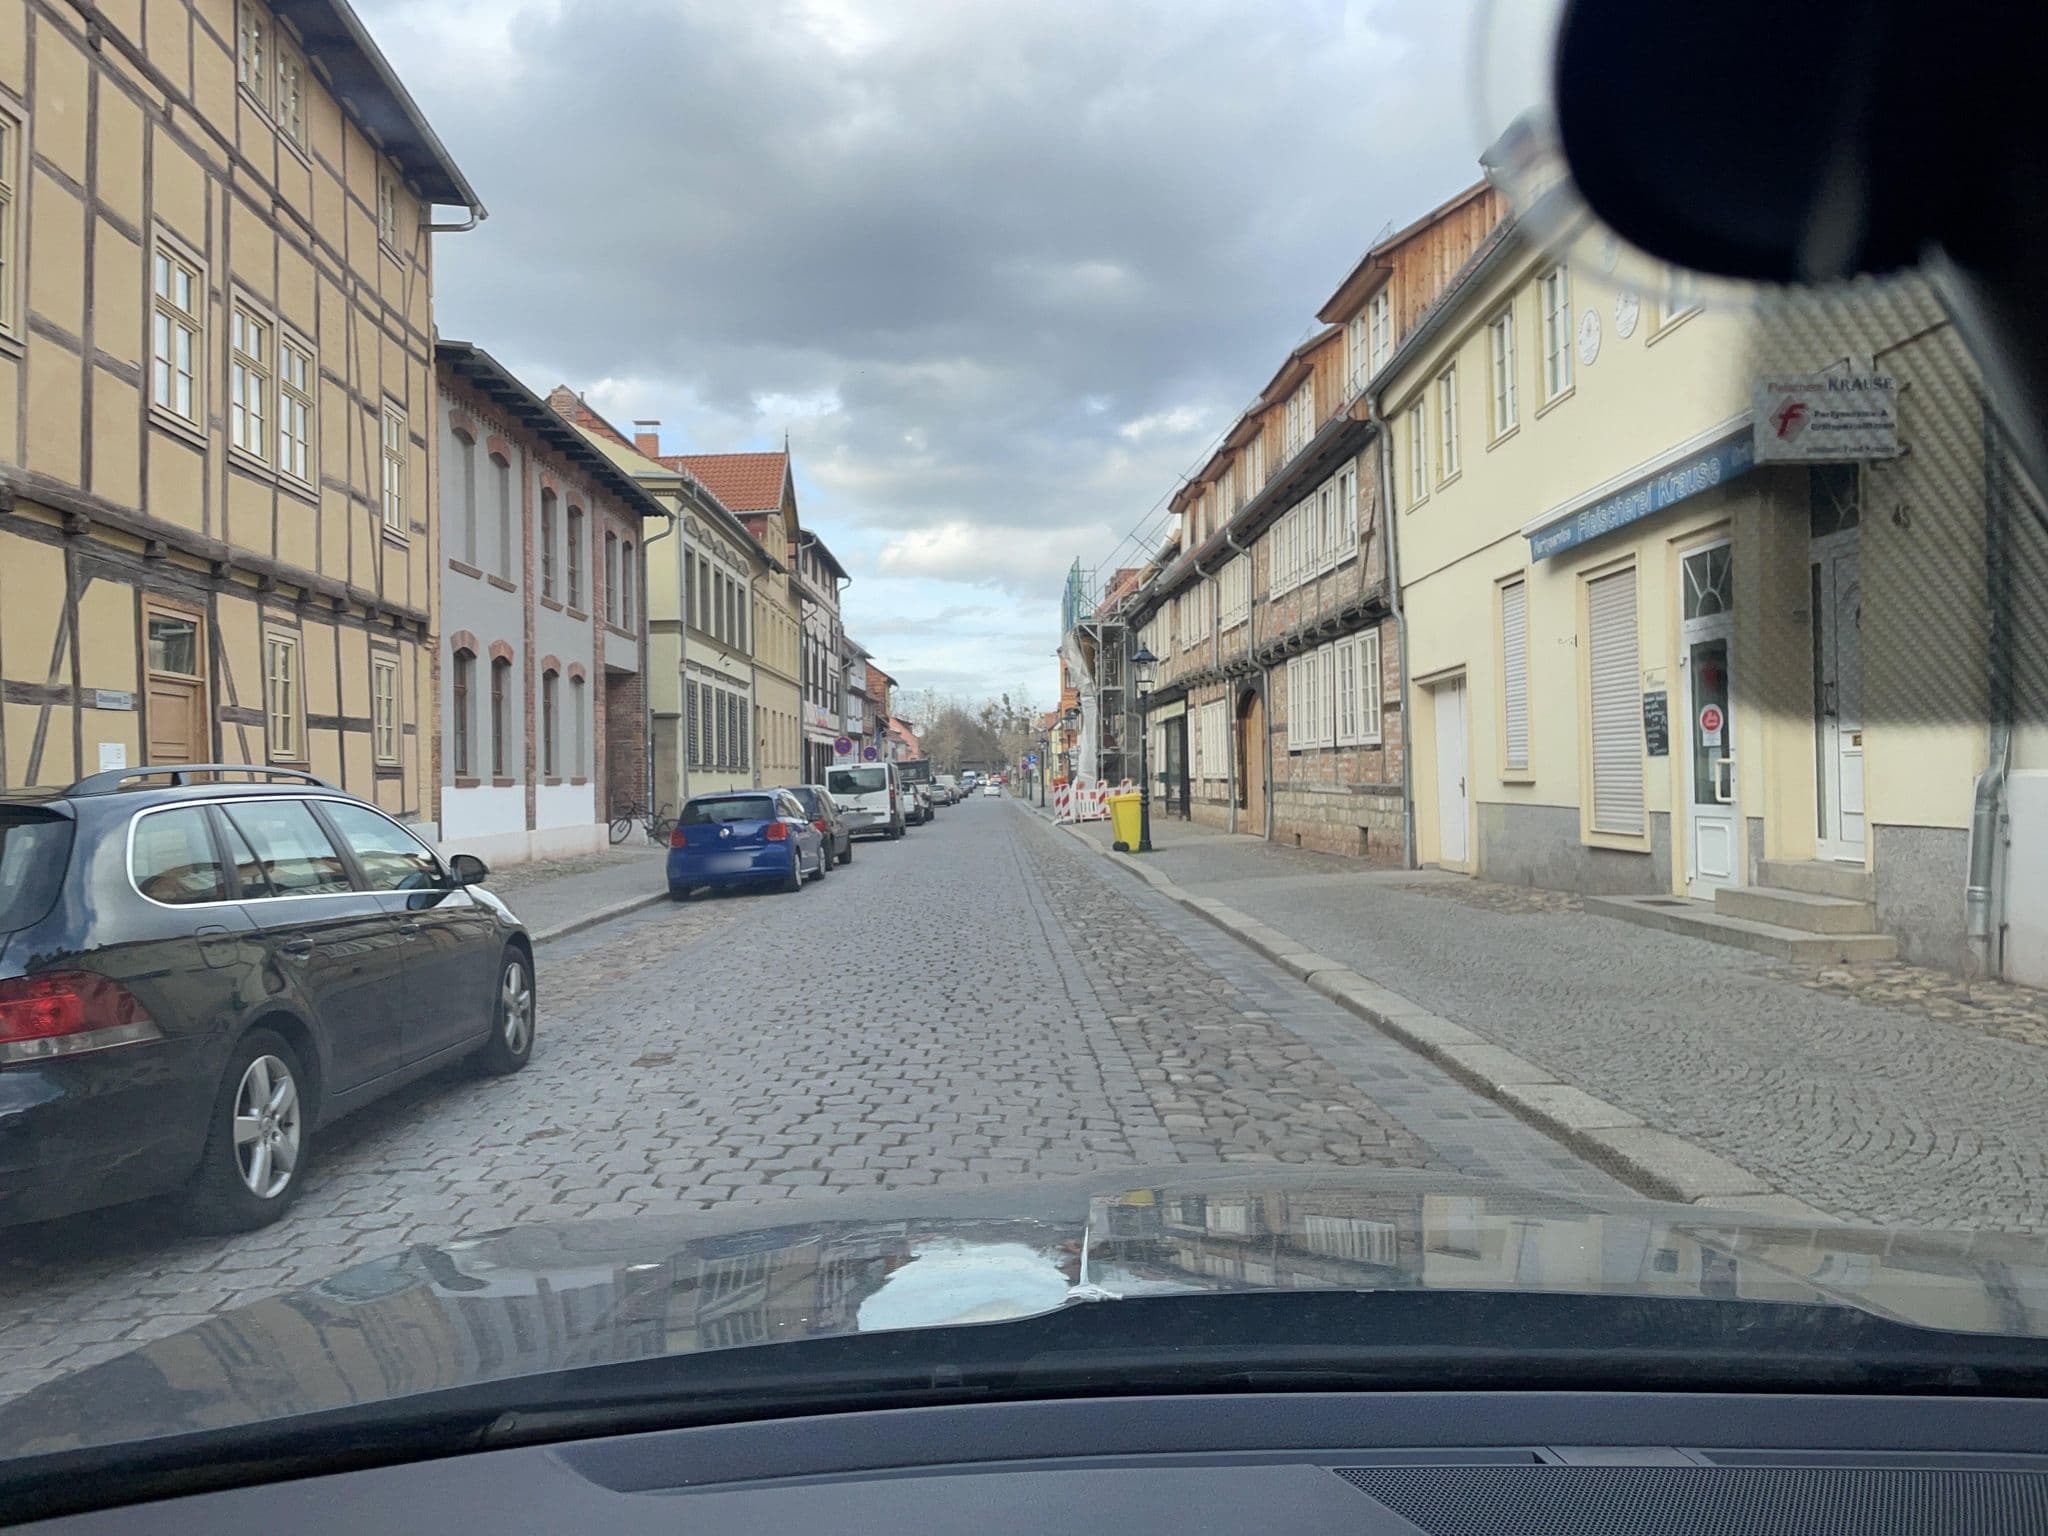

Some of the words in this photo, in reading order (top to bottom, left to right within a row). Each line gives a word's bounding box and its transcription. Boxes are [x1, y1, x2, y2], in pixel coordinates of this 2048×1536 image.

[1828, 377, 1894, 392] KRAUSE
[1576, 484, 1653, 543] Fleischerei
[1657, 456, 1722, 507] Krause
